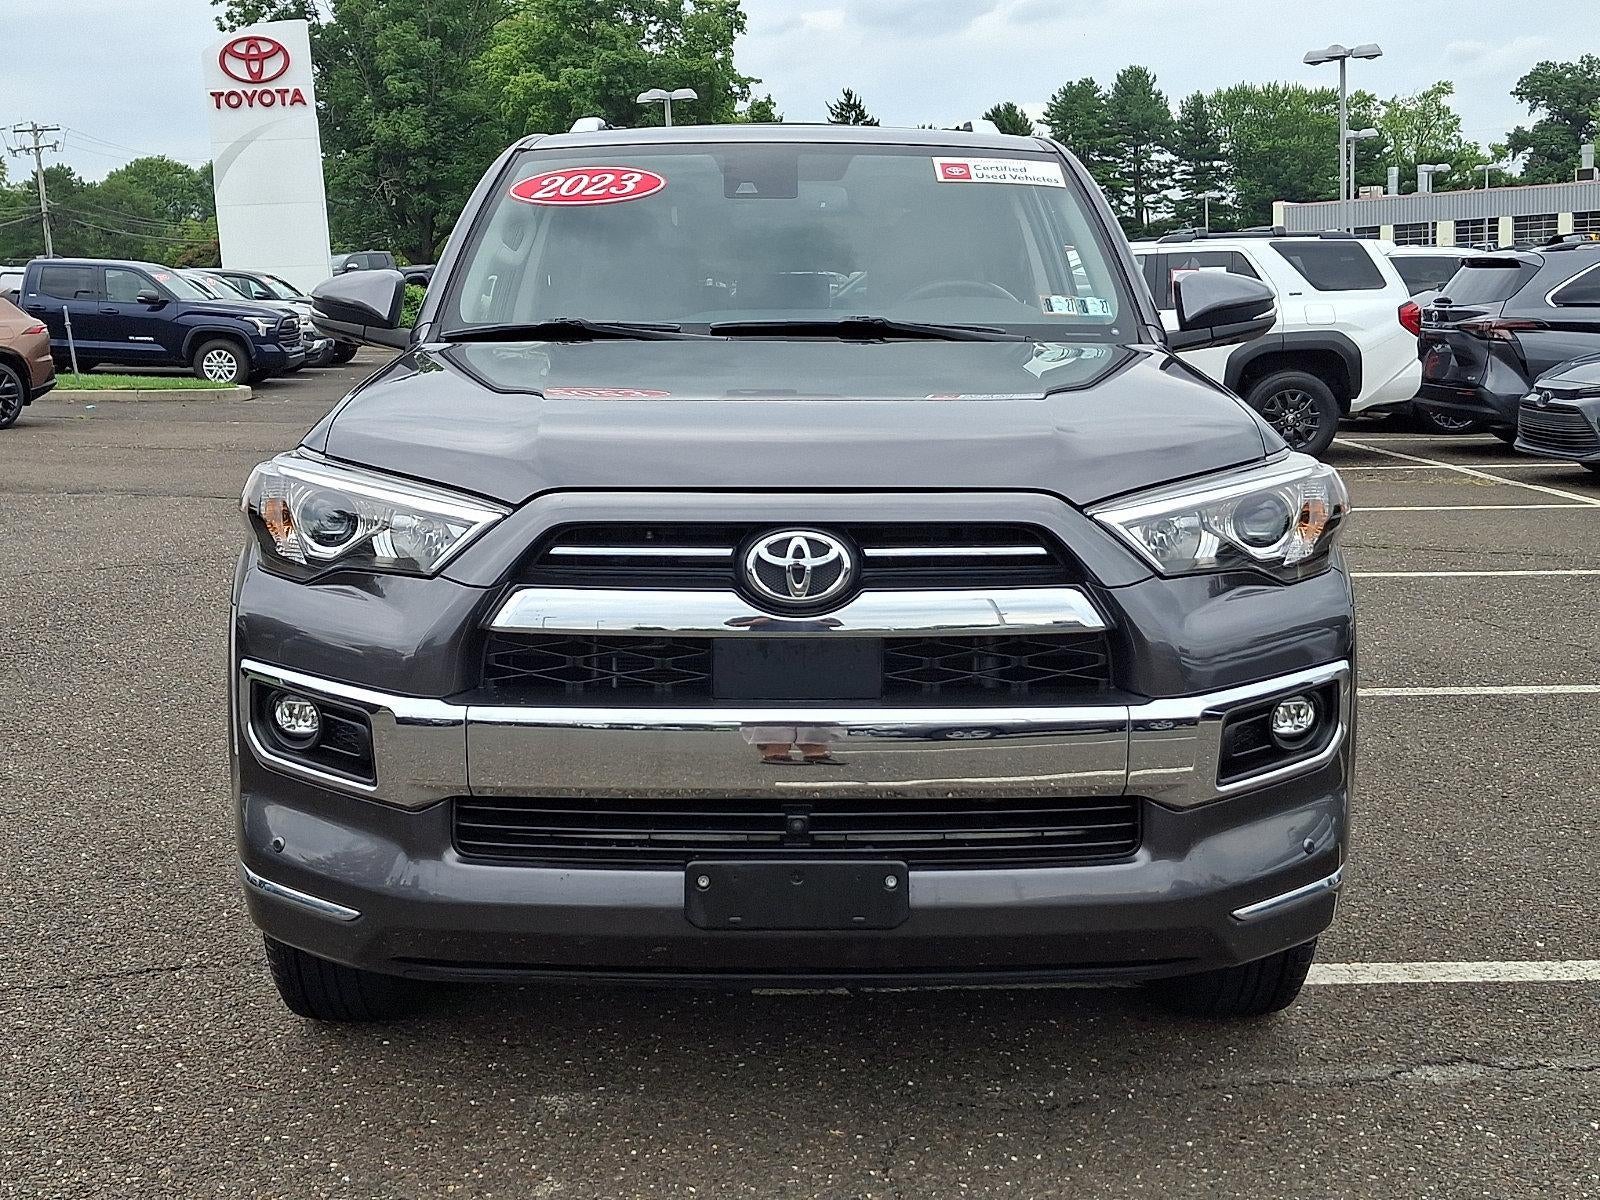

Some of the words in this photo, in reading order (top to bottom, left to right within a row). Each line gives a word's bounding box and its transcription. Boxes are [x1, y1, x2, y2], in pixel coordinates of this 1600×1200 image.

[210, 88, 307, 109] TOYOTA
[974, 164, 1027, 173] Certified
[530, 172, 643, 199] 2023
[1009, 173, 1060, 184] Vehicles
